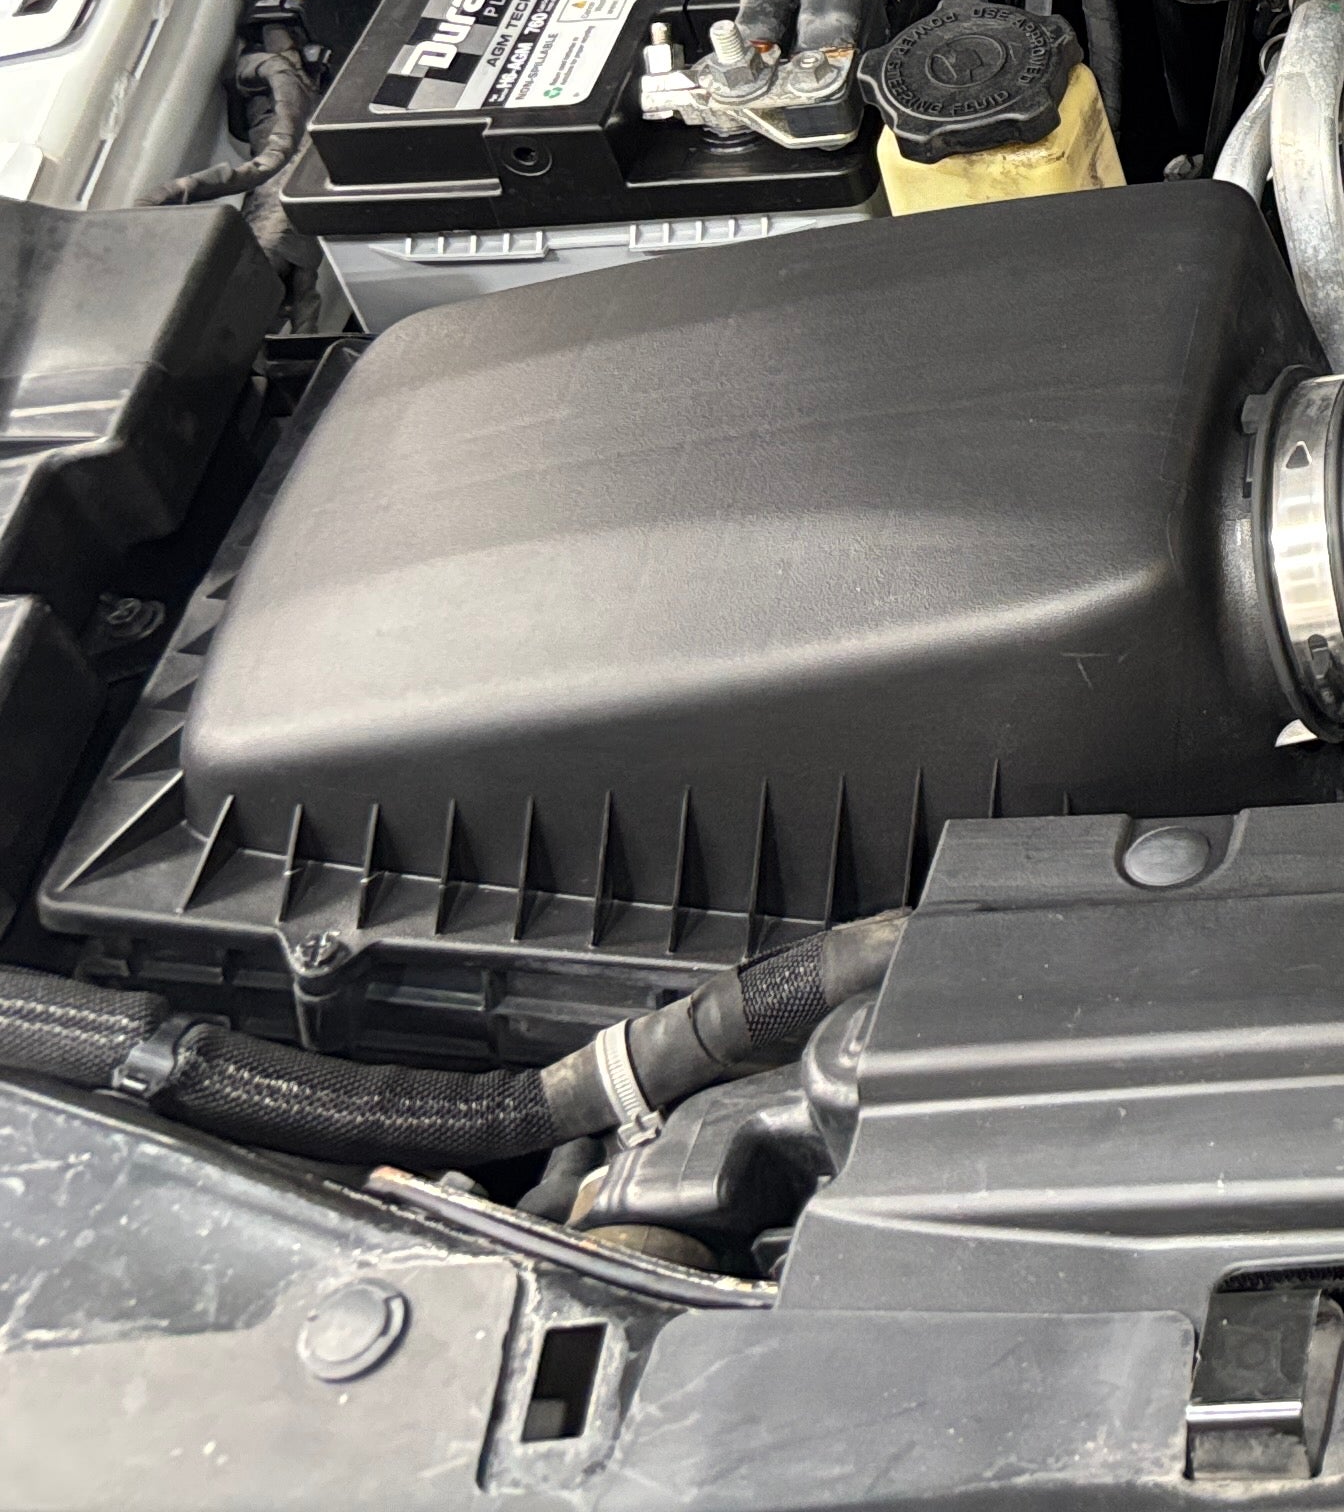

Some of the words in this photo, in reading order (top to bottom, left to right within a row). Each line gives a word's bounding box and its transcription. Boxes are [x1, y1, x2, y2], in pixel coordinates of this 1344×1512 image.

[523, 12, 550, 34] 760
[486, 33, 513, 67] AGM
[971, 7, 1010, 20] USE
[1012, 17, 1049, 86] APPROVED
[516, 32, 559, 100] NON-SPILLABLE
[952, 90, 1011, 116] FLUID
